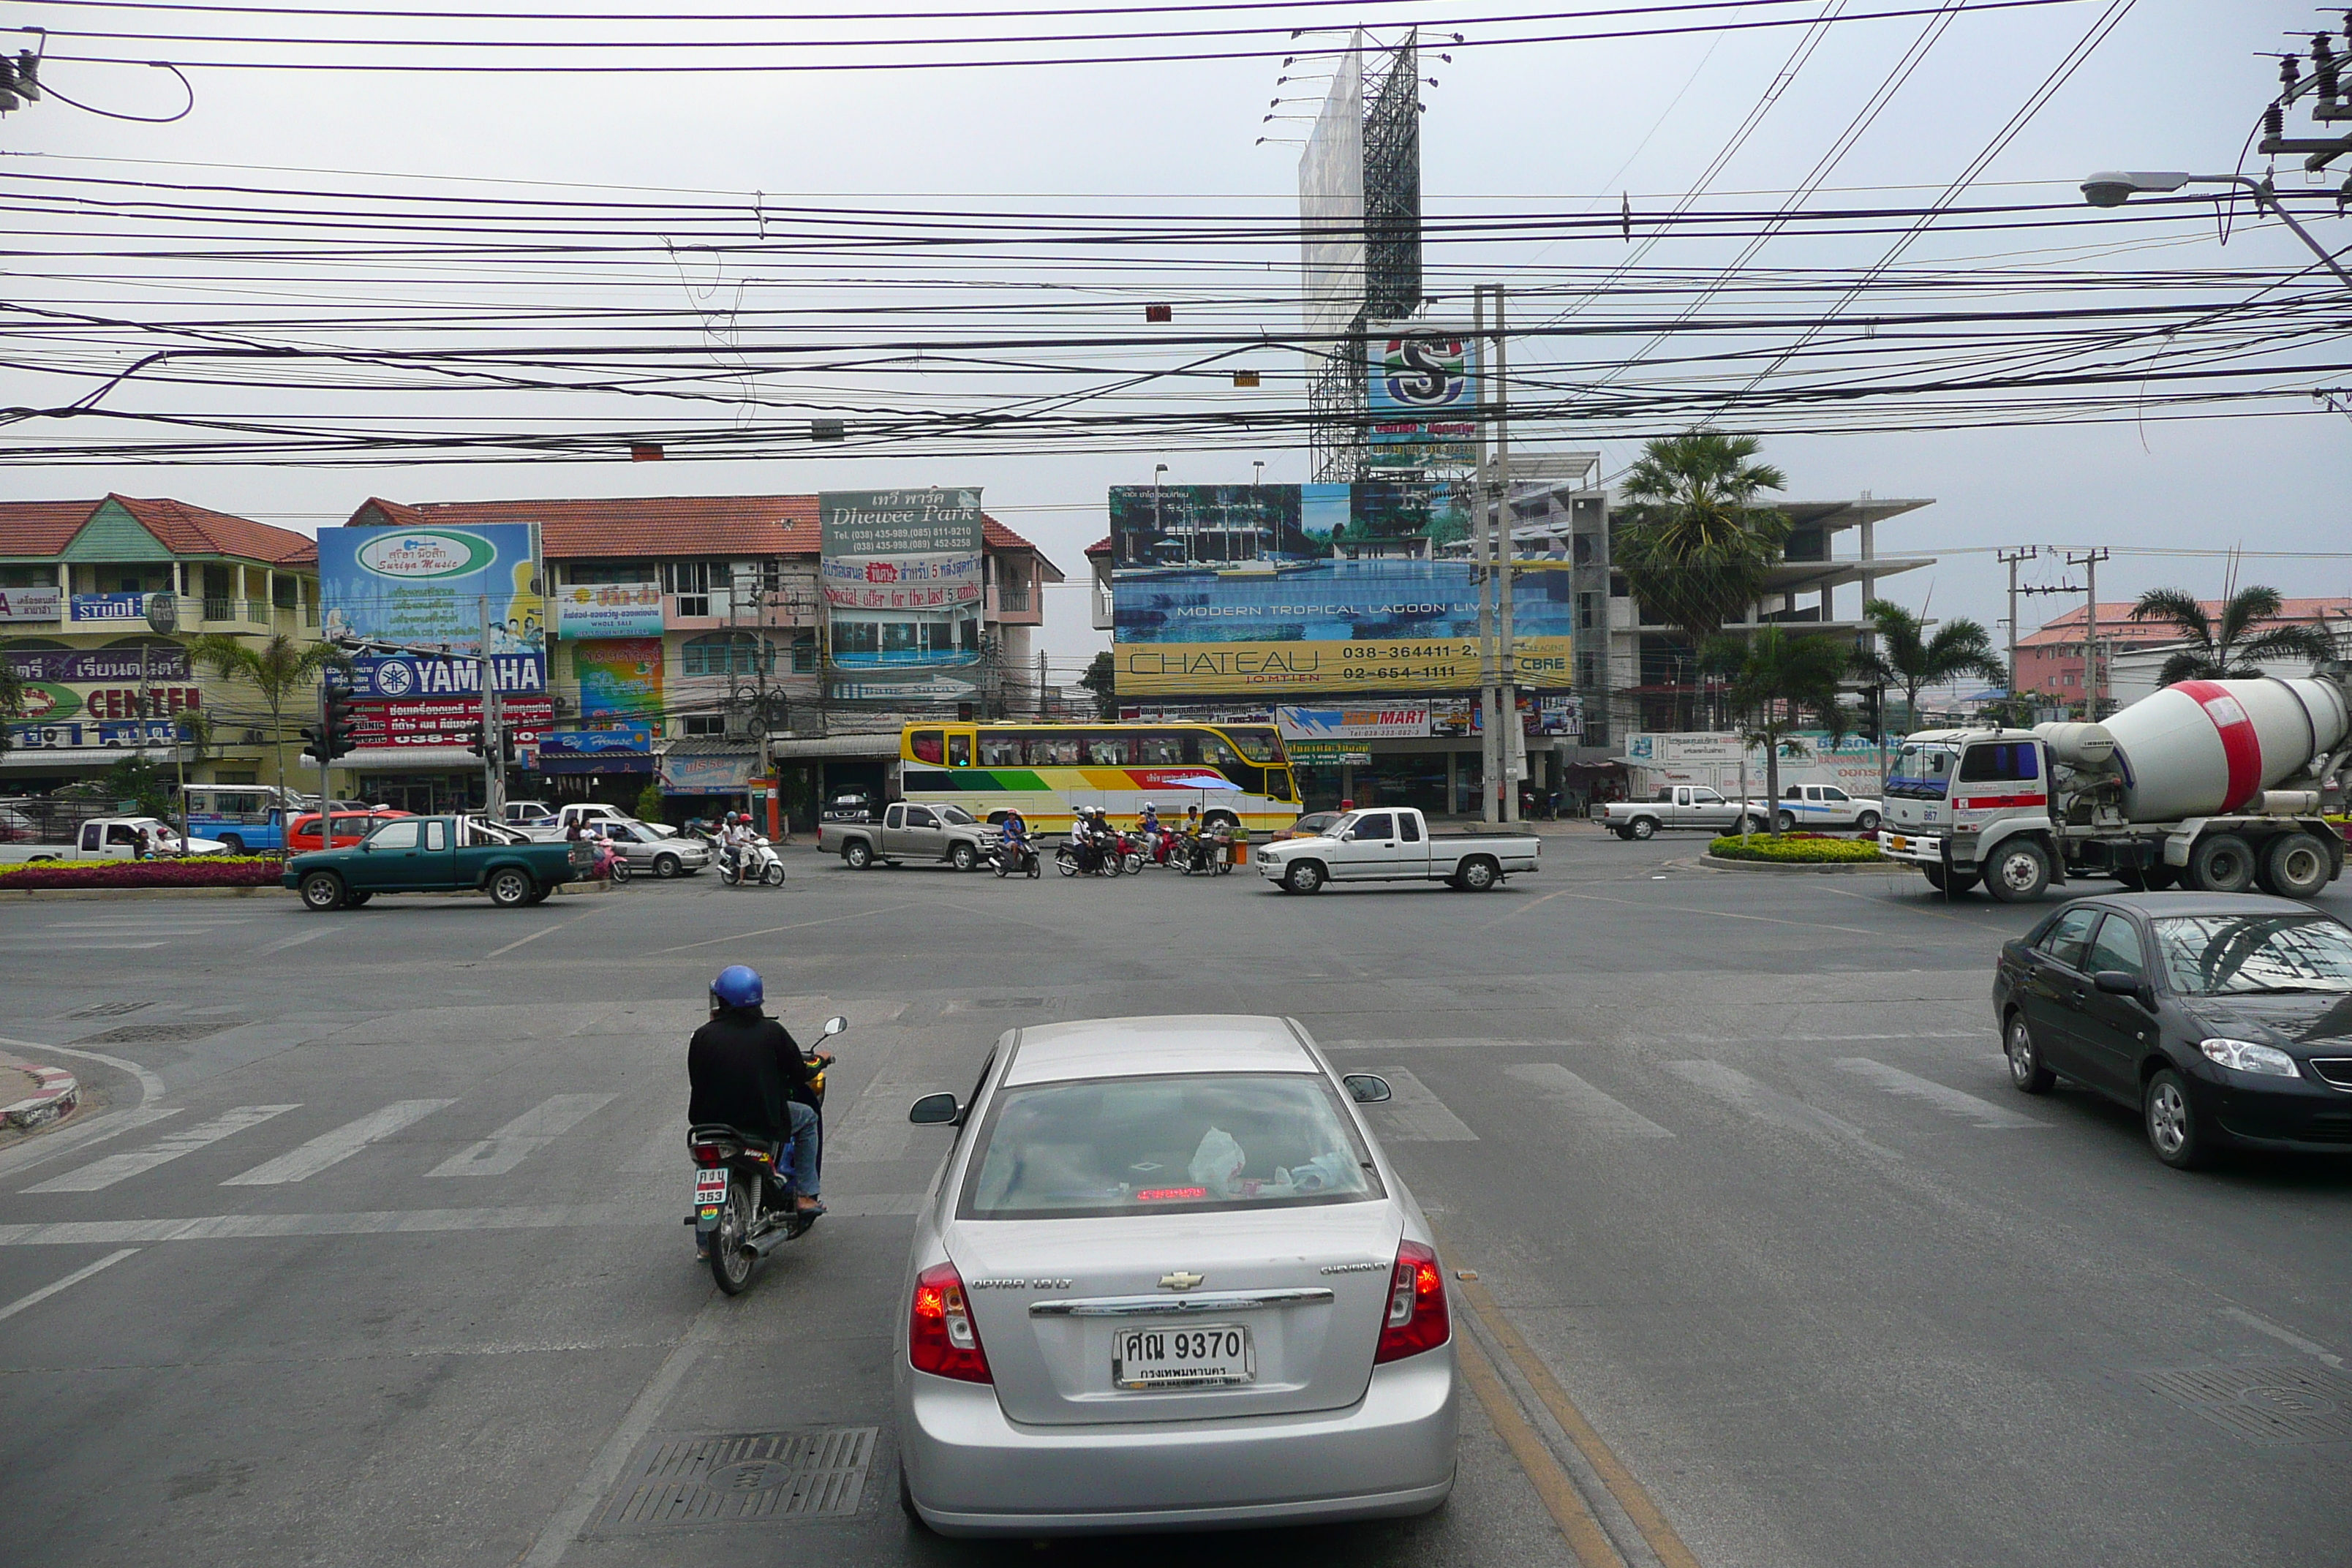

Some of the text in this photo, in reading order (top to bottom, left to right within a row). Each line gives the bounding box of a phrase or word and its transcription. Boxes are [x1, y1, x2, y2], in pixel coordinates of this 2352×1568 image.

[872, 491, 944, 506] เทวี พาร์ค
[830, 505, 975, 525] Dhewee Park
[834, 530, 849, 540] Tel.
[851, 530, 873, 540] (038)
[933, 527, 971, 536] 811-9210
[853, 541, 874, 552] (038)
[934, 539, 971, 548] 452-5258
[378, 559, 458, 571] Suriya Music
[900, 561, 930, 581] สำหรับ
[932, 565, 938, 578] 5
[823, 581, 979, 607] Special offer for the last 5 units
[1177, 606, 1262, 617] MODERN
[1268, 604, 1361, 615] TROPICAL
[1368, 603, 1446, 614] LAGOON
[1130, 650, 1319, 674] CHATEAU
[1520, 657, 1565, 670] CBRE
[415, 657, 540, 693] YAMAHA
[1343, 666, 1456, 679] 02-654-1111
[1245, 674, 1321, 685] JOMTIEN
[353, 734, 387, 745] MUSIC
[562, 735, 582, 749] By
[589, 734, 633, 746] House
[698, 1191, 723, 1202] 353
[1320, 1262, 1387, 1275] CHEVROLET
[972, 1278, 1025, 1290] OPTRA
[1175, 1331, 1240, 1360] 9370
[1140, 1366, 1226, 1379] กรงเทพมหานคร
